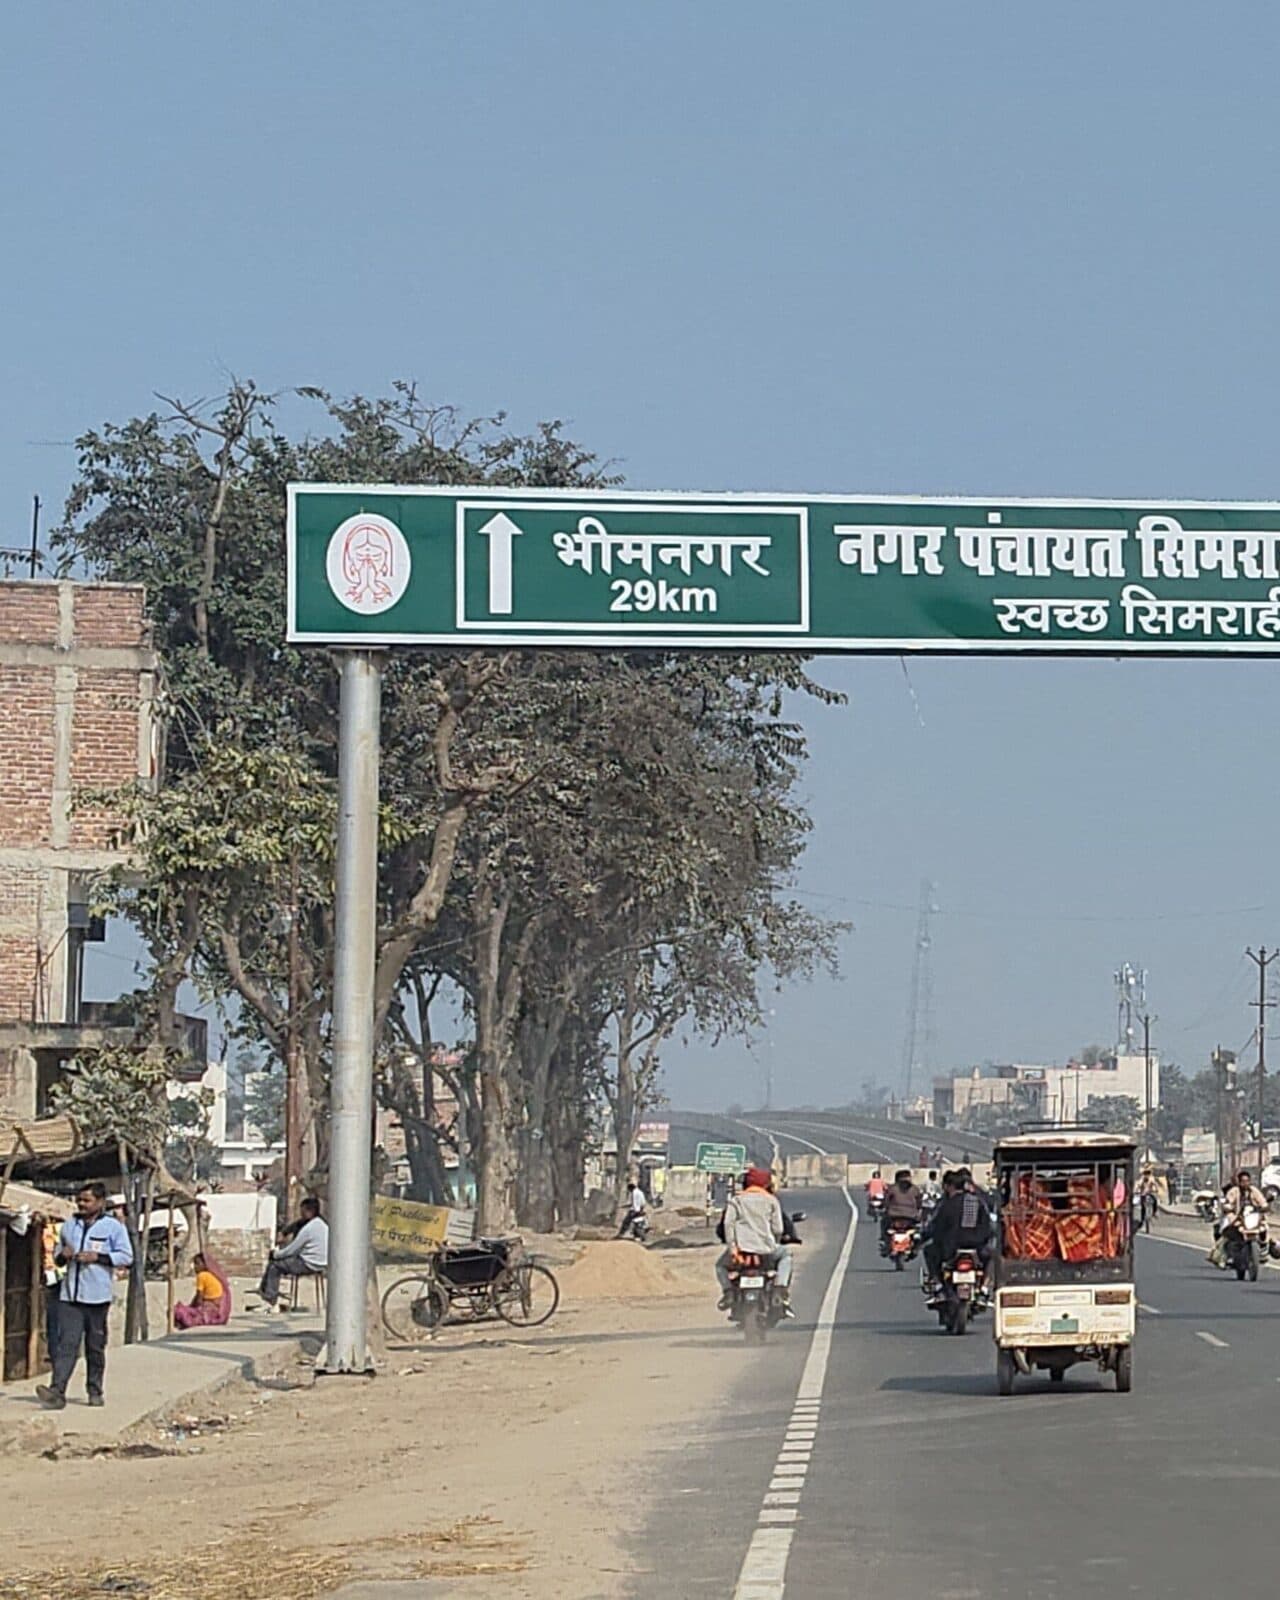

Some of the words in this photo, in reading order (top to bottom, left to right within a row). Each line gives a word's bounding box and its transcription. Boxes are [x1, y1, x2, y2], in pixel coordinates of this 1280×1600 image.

[553, 516, 771, 577] भीमनगर
[834, 524, 947, 576] नगर
[954, 511, 1129, 578] पंचायत
[609, 579, 718, 612] 29km
[992, 598, 1111, 633] स्वच्छ
